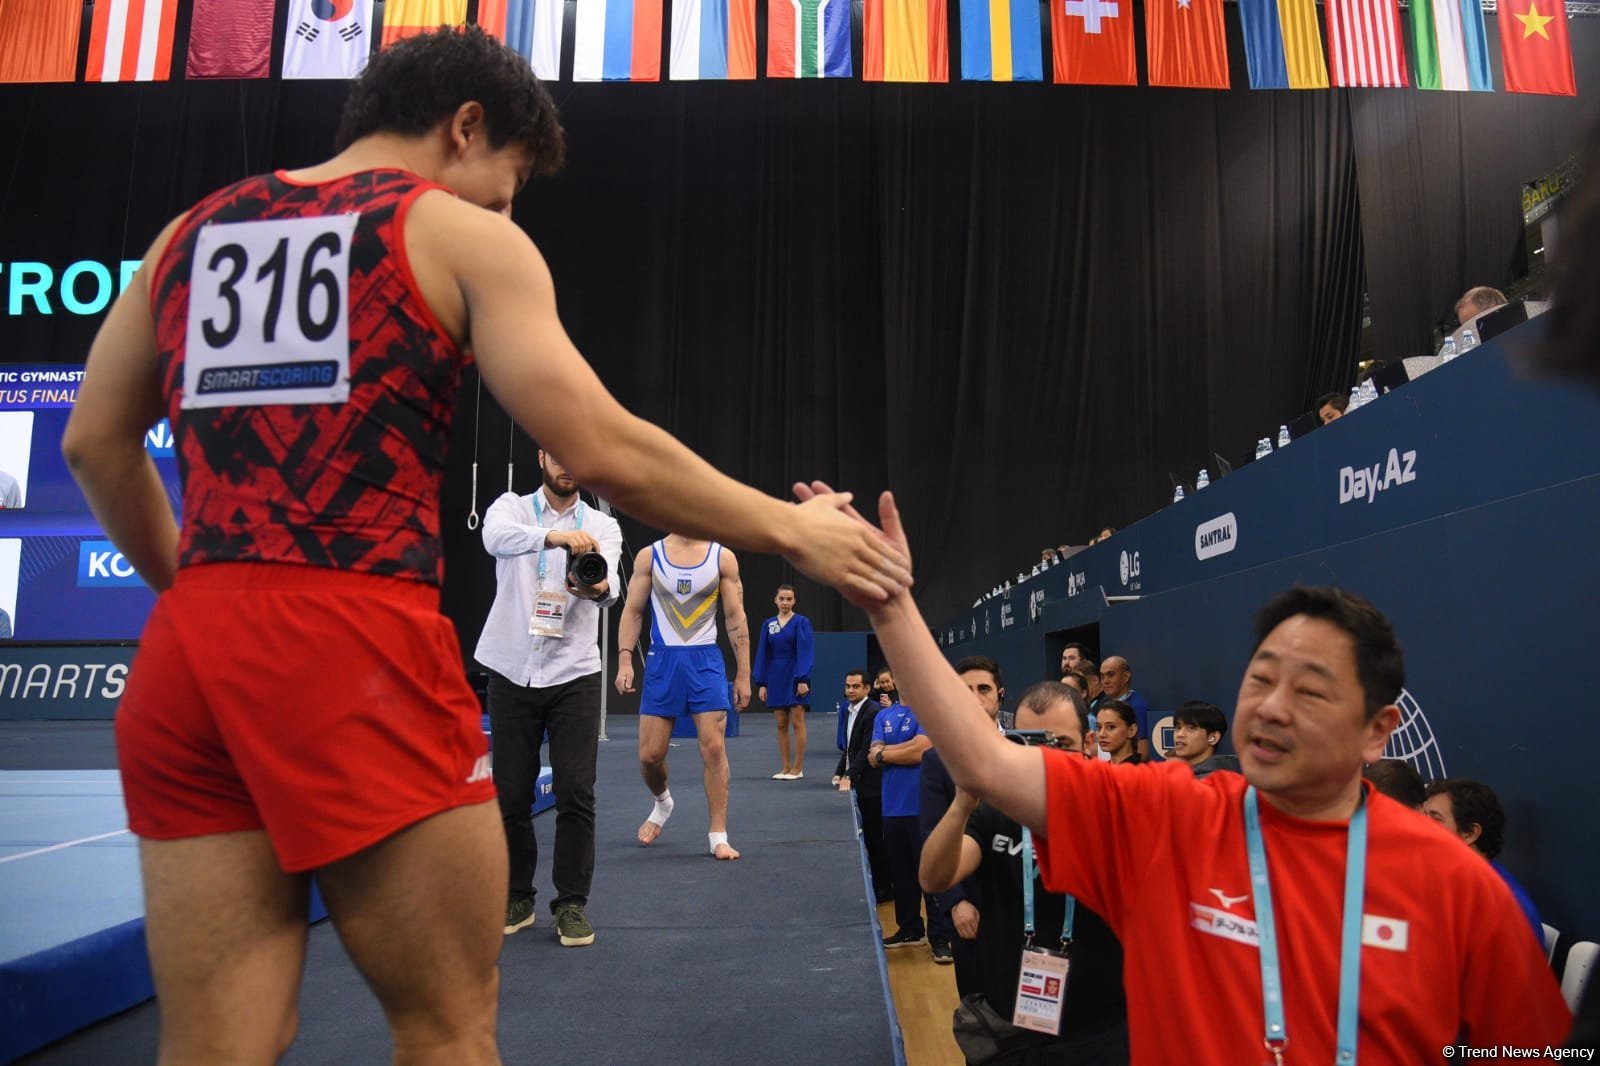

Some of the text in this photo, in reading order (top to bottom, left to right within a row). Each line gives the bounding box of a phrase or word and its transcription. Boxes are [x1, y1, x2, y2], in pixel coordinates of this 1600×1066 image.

[0, 260, 144, 316] RO
[201, 231, 342, 349] 316
[202, 365, 333, 390] SMARTSCORING
[1340, 448, 1417, 504] Day.Az
[1200, 524, 1231, 549] SANTRAL
[1129, 550, 1140, 578] LG
